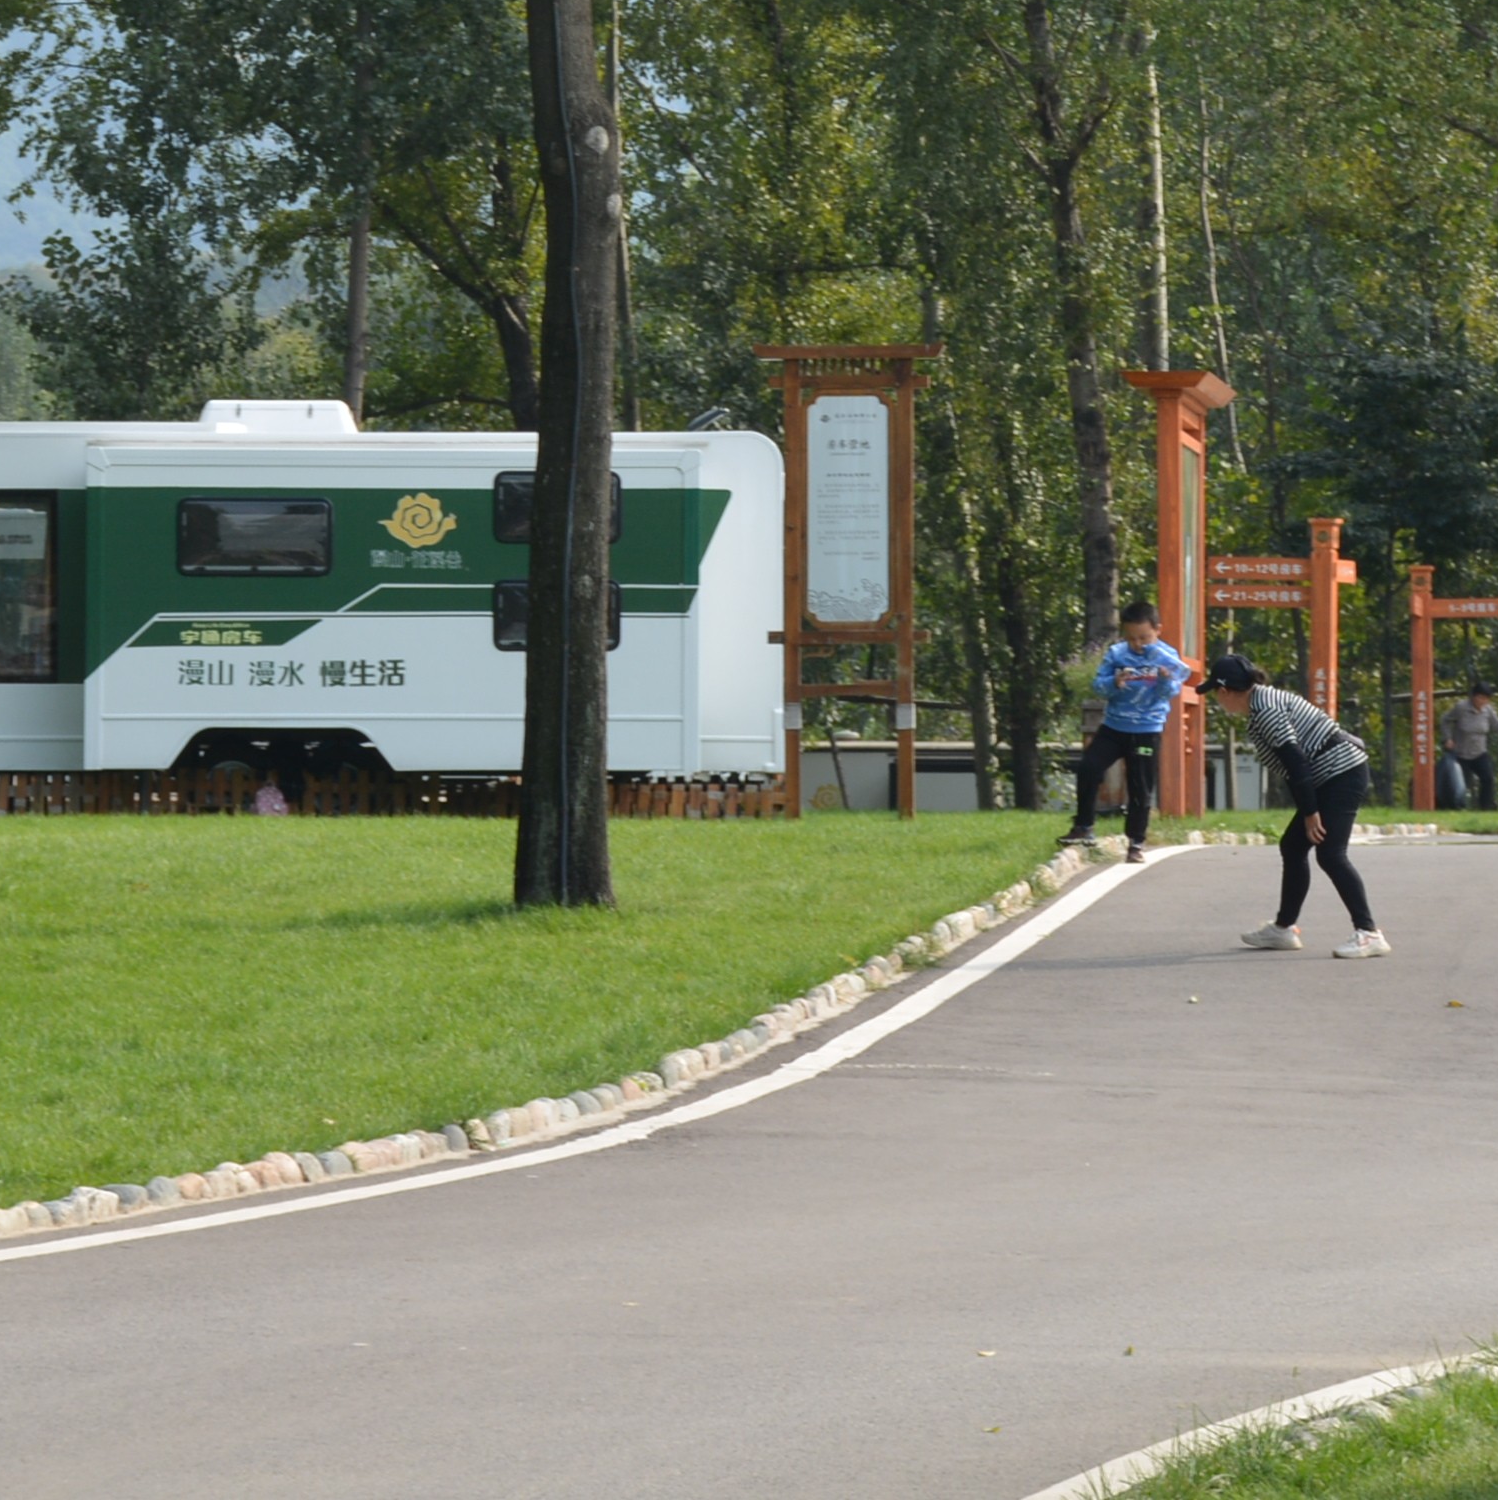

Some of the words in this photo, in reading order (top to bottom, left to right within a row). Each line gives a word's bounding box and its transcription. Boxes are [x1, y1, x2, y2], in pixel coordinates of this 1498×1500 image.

[180, 630, 263, 645] 宇通房车
[178, 659, 235, 686] 漫山
[248, 660, 305, 687] 漫水
[319, 659, 406, 687] 慢生活
